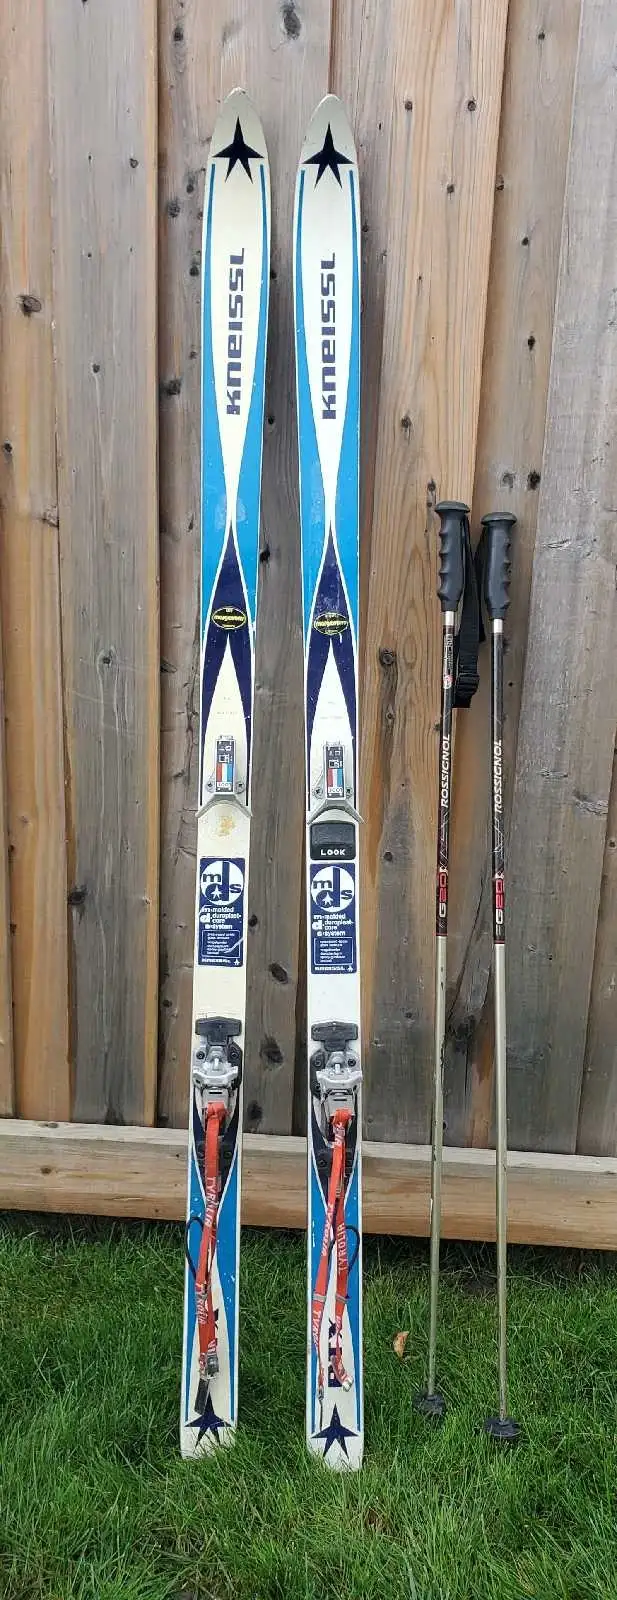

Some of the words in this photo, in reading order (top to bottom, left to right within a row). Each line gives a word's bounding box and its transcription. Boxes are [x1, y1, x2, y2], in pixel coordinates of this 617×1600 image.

[440, 733, 450, 808] ROSSIGNOL
[493, 739, 503, 813] ROSSIGNOL
[320, 848, 346, 857] LOOK
[338, 1222, 348, 1276] TYROLIA
